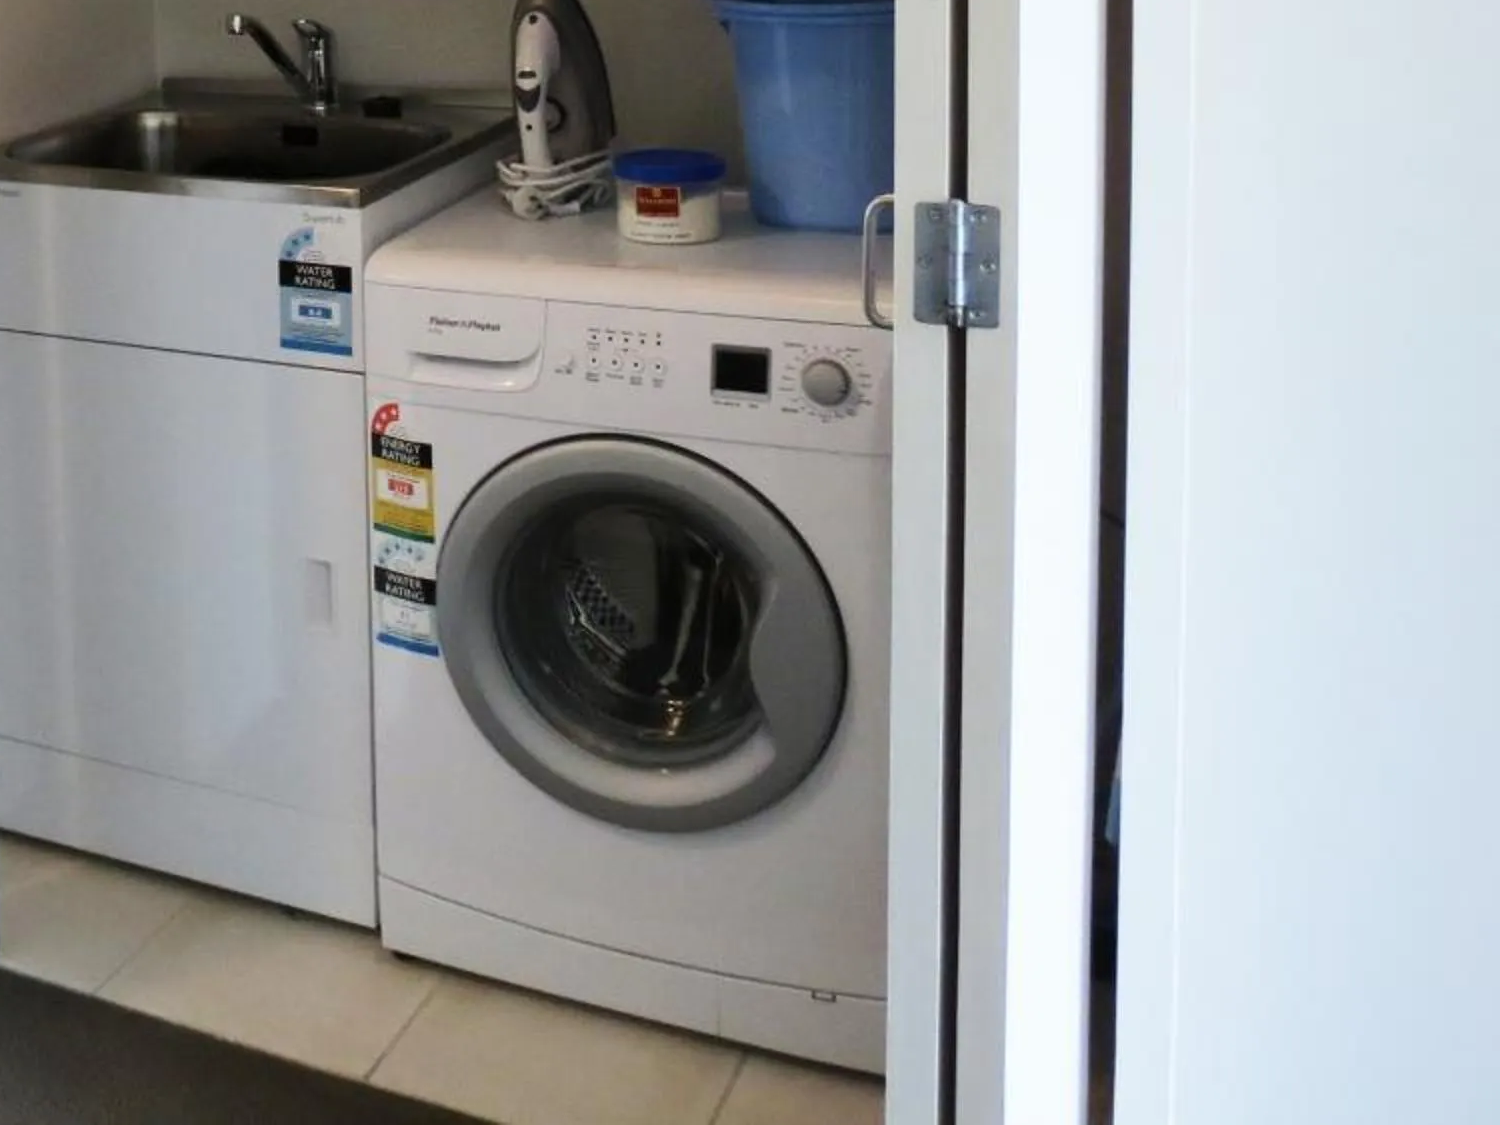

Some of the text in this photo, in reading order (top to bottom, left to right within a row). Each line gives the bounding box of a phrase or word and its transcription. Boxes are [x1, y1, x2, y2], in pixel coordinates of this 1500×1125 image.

[296, 264, 333, 277] WATER
[294, 275, 336, 290] RATING
[381, 436, 420, 454] ENERGY
[382, 448, 420, 467] RATING
[387, 572, 421, 589] WATER
[386, 582, 425, 603] RATING
